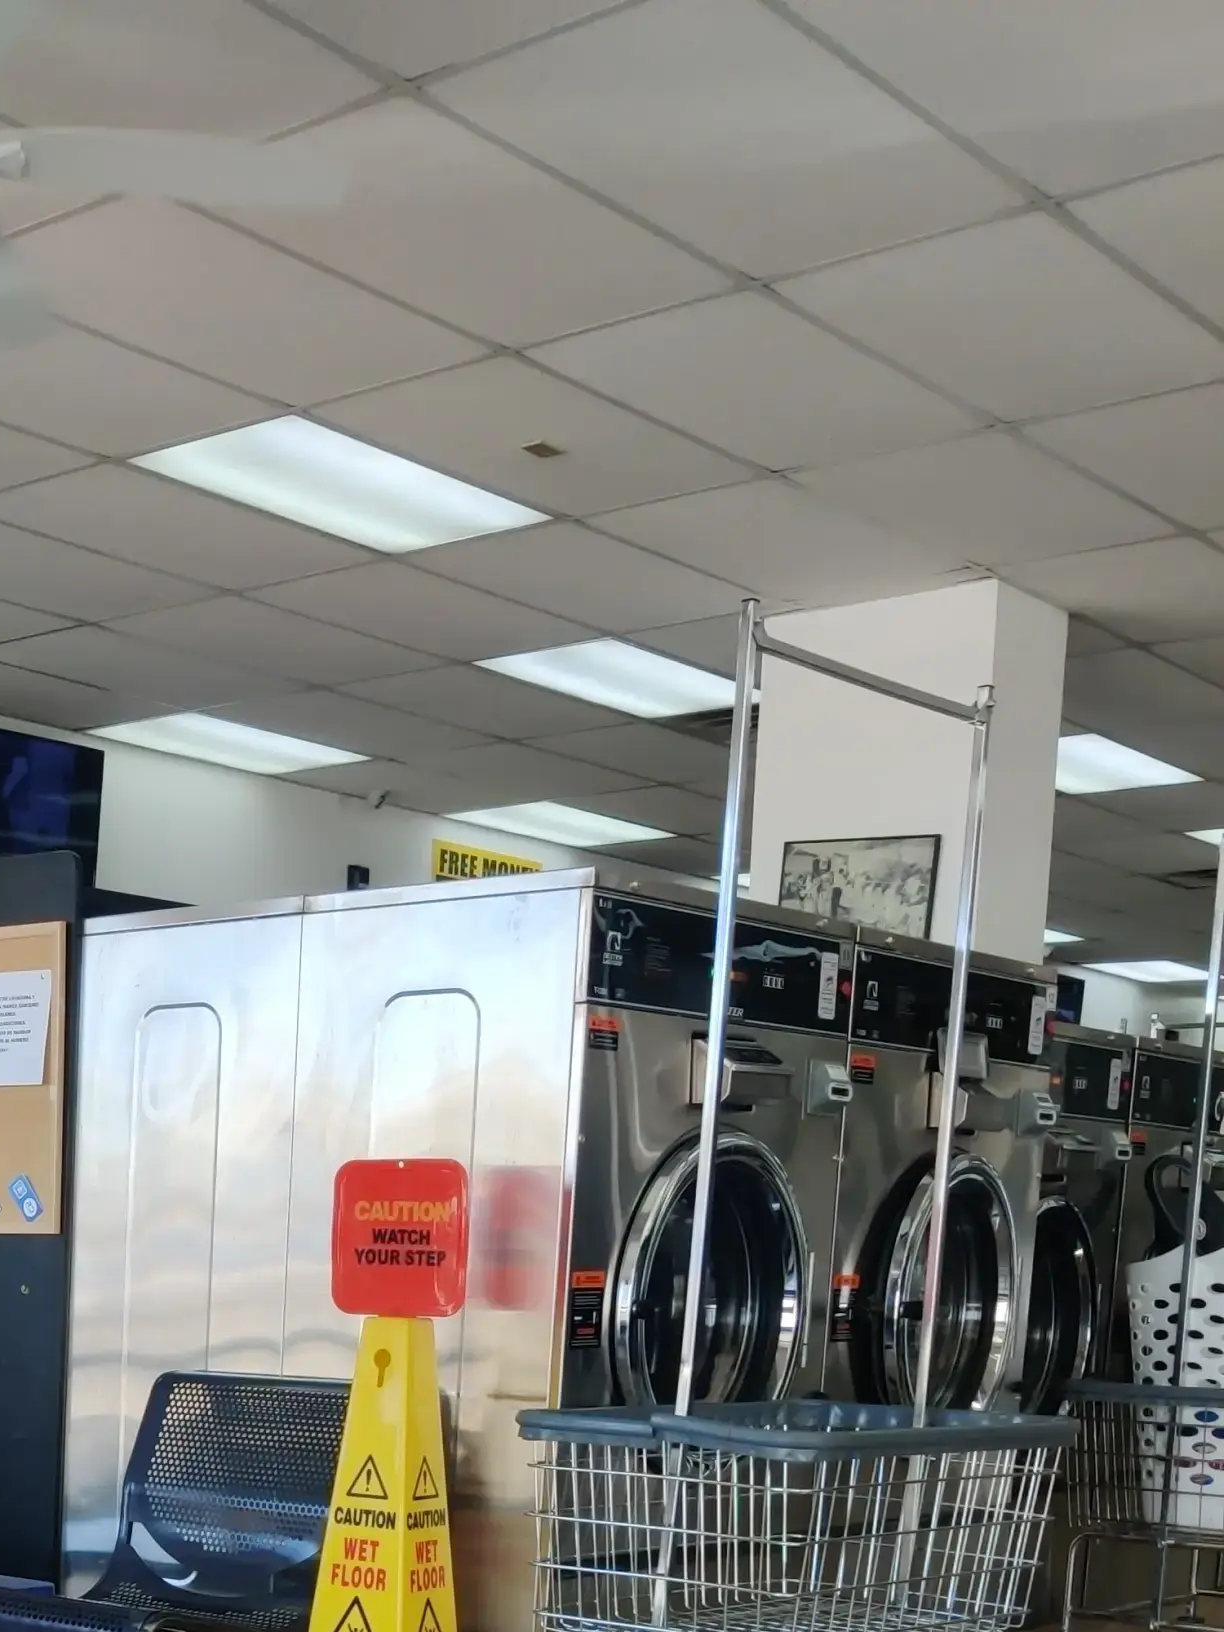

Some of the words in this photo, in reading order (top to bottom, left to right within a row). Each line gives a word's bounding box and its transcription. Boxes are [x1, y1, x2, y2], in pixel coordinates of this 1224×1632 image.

[439, 848, 478, 878] FREE
[354, 1200, 451, 1222] CAUTION
[372, 1228, 431, 1245] WATCH
[354, 1248, 401, 1265] YOUR
[404, 1250, 447, 1267] STEP
[334, 1506, 396, 1530] CAUTION
[406, 1508, 446, 1531] CAUTION
[344, 1537, 380, 1562] WET
[415, 1539, 438, 1564] WET
[331, 1563, 387, 1592] FLOOR
[410, 1566, 446, 1593] FLOOR
